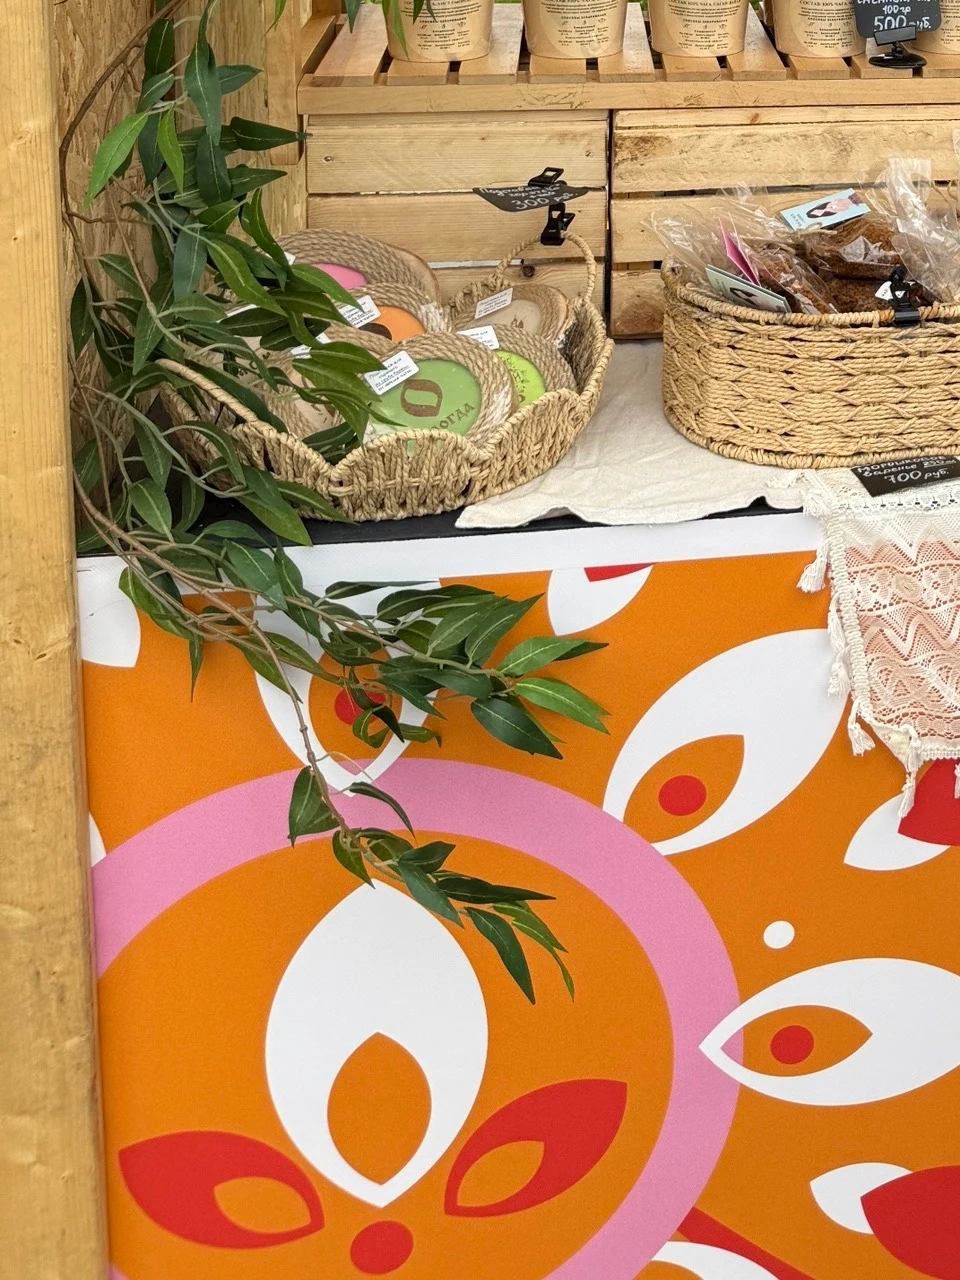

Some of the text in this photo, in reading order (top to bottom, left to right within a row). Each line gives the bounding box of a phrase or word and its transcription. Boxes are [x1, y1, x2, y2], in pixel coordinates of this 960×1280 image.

[882, 6, 899, 15] 100
[873, 15, 932, 32] 500 уб.
[511, 198, 550, 210] 300
[862, 464, 918, 477] варенье
[883, 467, 950, 484] 700 руб.
